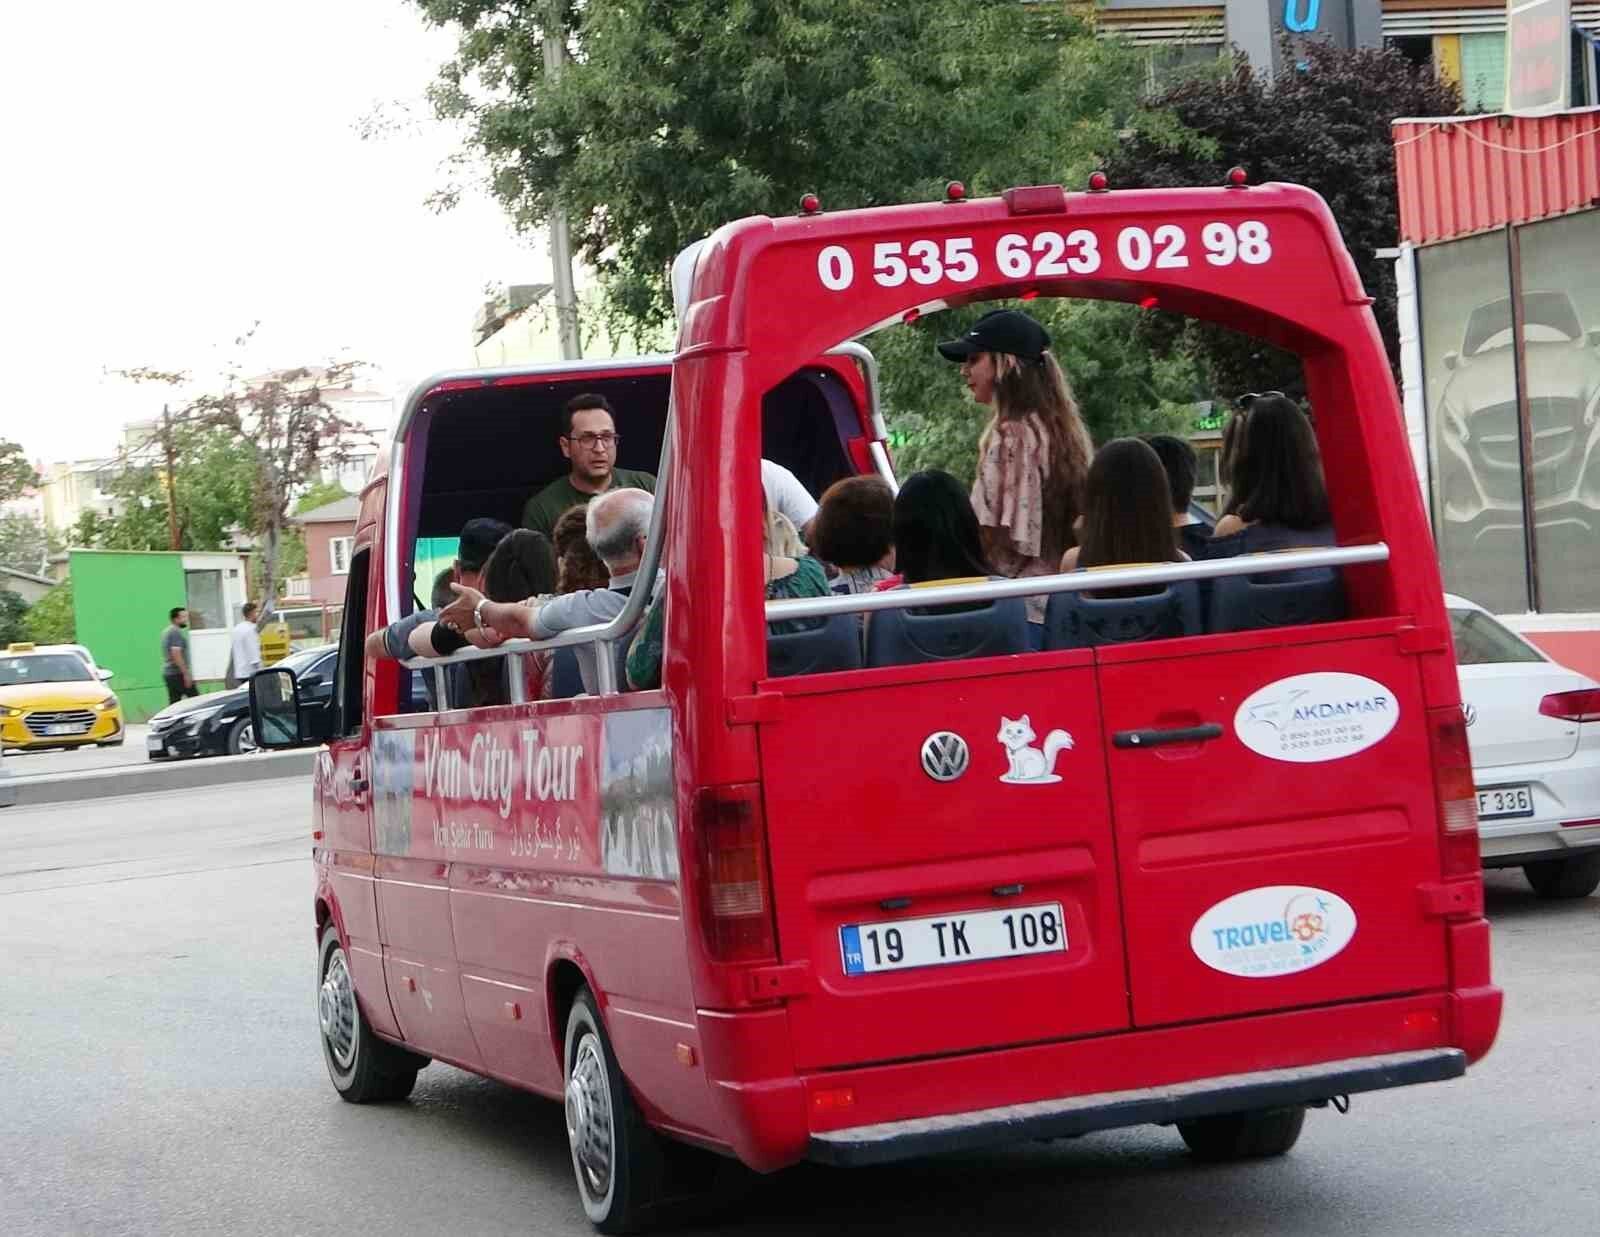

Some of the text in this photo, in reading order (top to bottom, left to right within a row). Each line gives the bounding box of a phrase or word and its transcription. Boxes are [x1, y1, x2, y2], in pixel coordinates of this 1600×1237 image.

[818, 220, 1273, 291] 0 535 623 02 98
[1293, 697, 1388, 720] AKDAMAR
[424, 728, 584, 819] Van City Tour
[1494, 791, 1527, 811] 336
[473, 823, 495, 850] Turu
[867, 911, 1058, 965] 19 TK 108
